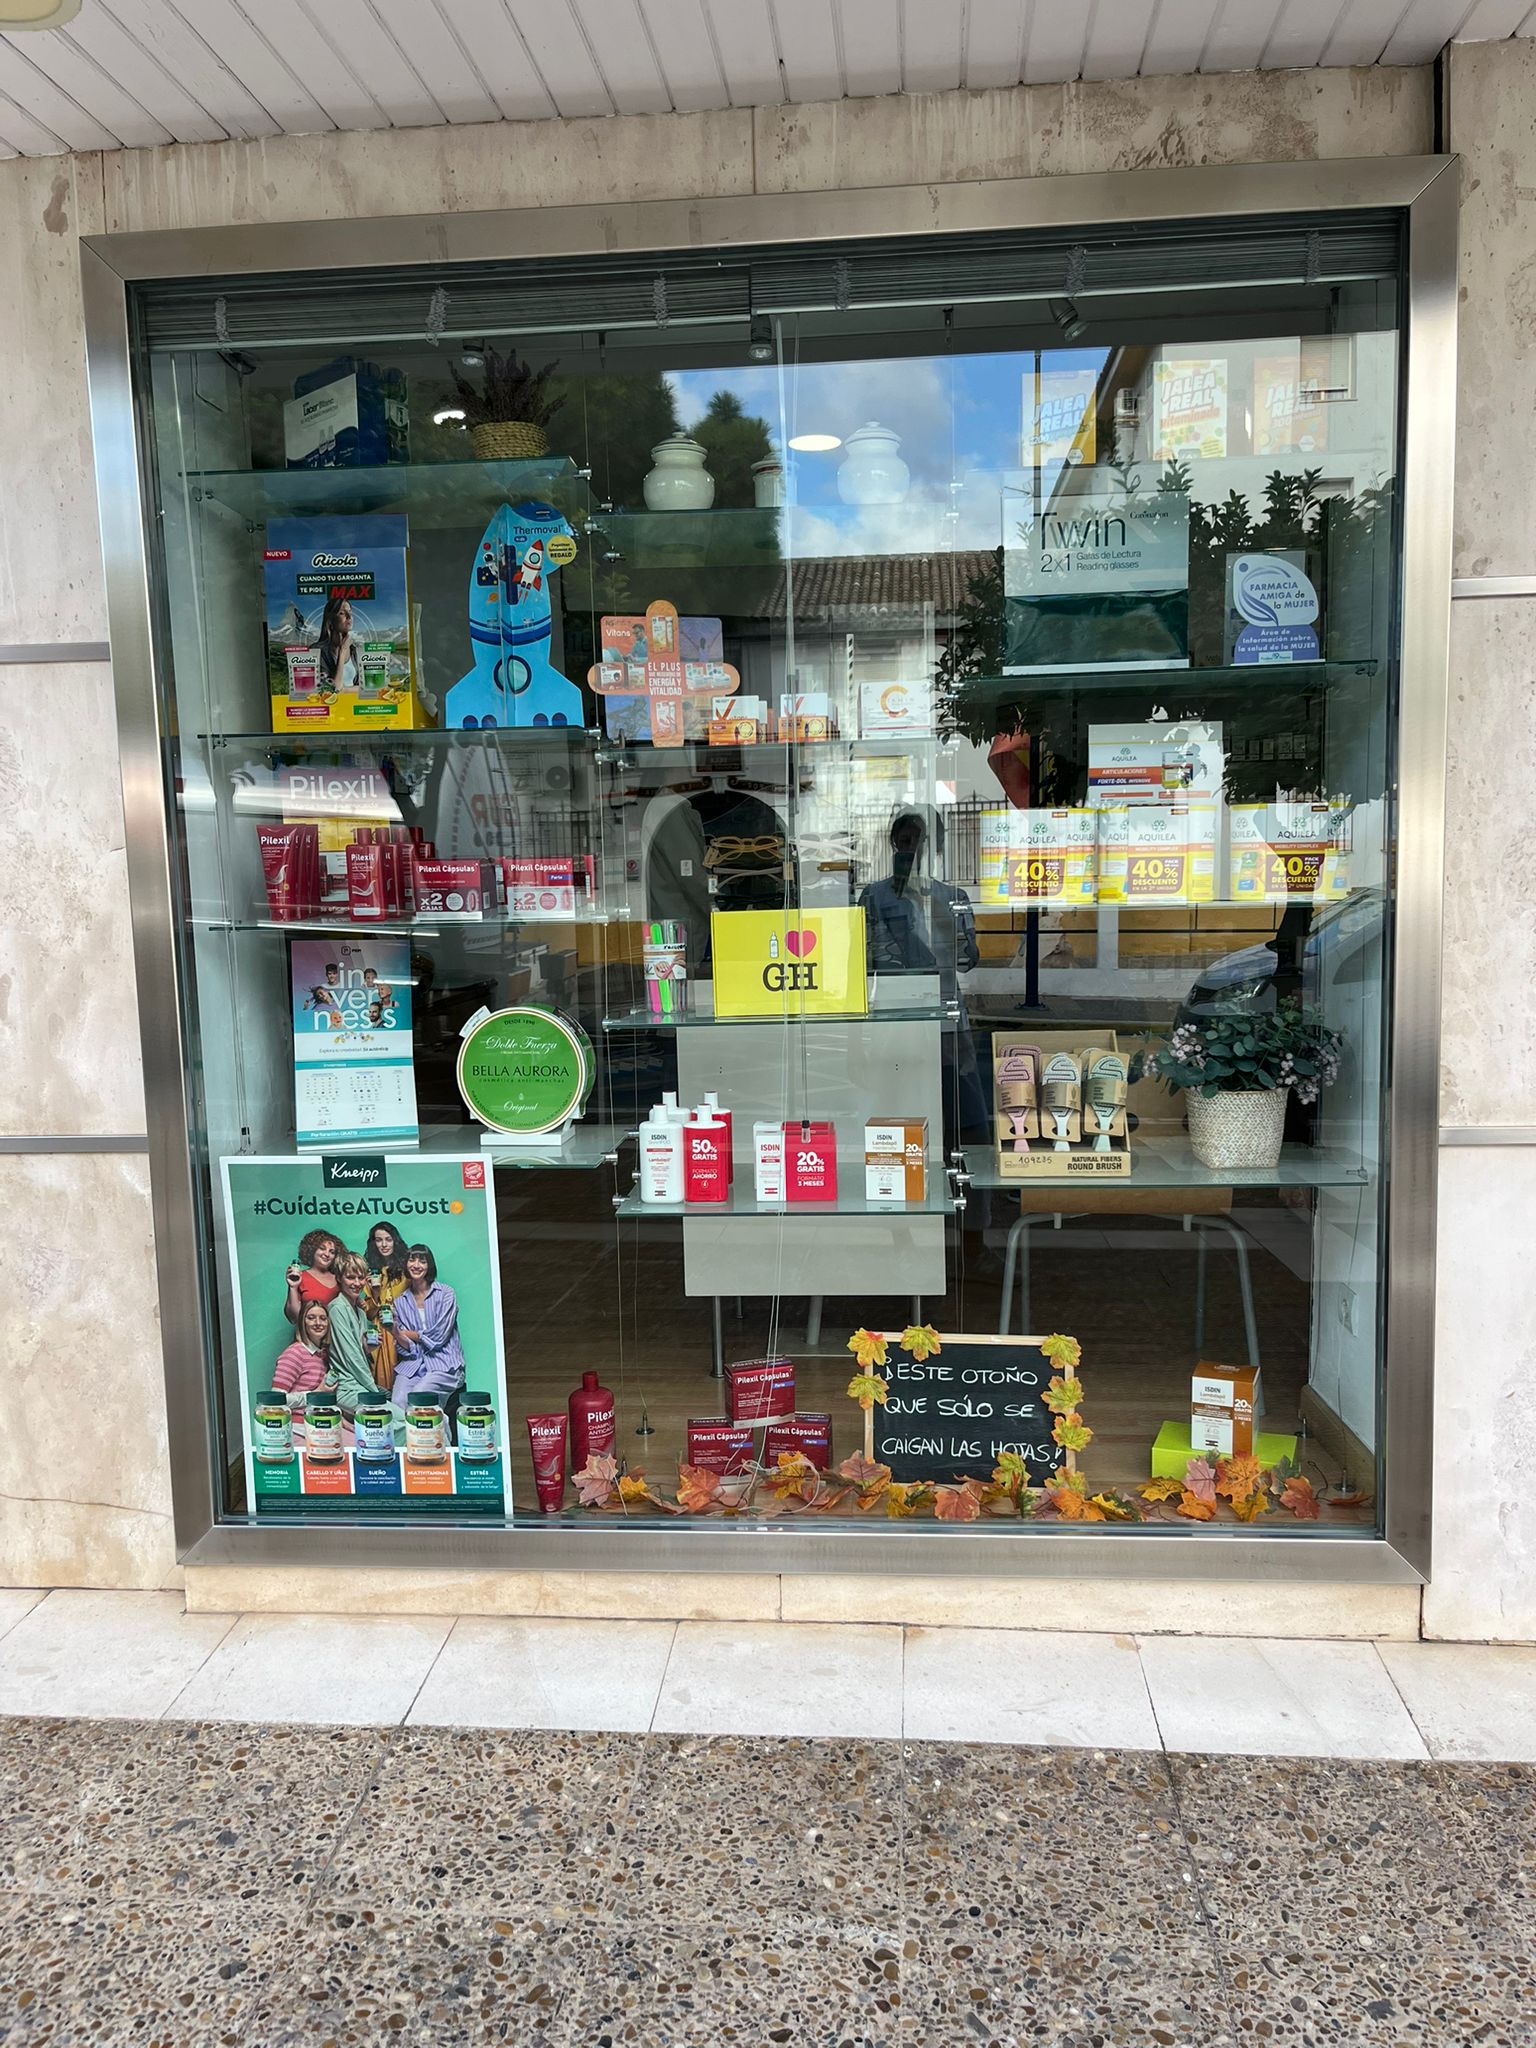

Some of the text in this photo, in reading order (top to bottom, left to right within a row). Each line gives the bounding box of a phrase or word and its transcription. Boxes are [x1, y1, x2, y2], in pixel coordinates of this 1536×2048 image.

[1163, 371, 1217, 405] JALEA
[1168, 388, 1214, 415] REAL
[513, 525, 561, 535] Thermoval
[1033, 510, 1126, 550] Twin
[313, 554, 357, 567] Ricola
[1040, 553, 1071, 573] 2x1
[1100, 550, 1111, 560] de
[1111, 550, 1142, 559] Lectura
[1076, 561, 1140, 572] Reading glasses
[330, 585, 372, 599] MAX
[1250, 582, 1298, 591] FARMACIA
[1260, 590, 1305, 600] AMIGA de
[1284, 600, 1315, 609] MUJER
[606, 629, 631, 637] Vitans
[1247, 644, 1267, 652] salud
[291, 656, 316, 664] Ricola
[361, 654, 386, 662] Ricola
[648, 662, 681, 671] EL PLUS
[675, 678, 681, 686] Y
[649, 687, 682, 696] VITALIDAD
[289, 774, 377, 800] Pilexil
[260, 836, 290, 844] Pilexil
[1138, 833, 1176, 841] AQUILEA
[1277, 830, 1317, 839] AQUILEA
[351, 853, 375, 861] Pilexil
[418, 864, 475, 874] Pilexil Cápsulas
[510, 863, 567, 872] Pilexil Cápsulas
[420, 892, 443, 906] x2
[338, 962, 365, 989] in
[762, 962, 818, 992] GH
[485, 1035, 558, 1055] Doble Fuerza
[472, 1065, 569, 1077] BELLA AURORA
[503, 1101, 538, 1114] Original
[692, 1139, 717, 1153] 50%
[797, 1151, 824, 1166] 20%
[330, 1161, 380, 1183] Kneipp
[737, 1371, 790, 1384] Pilexil Cápsulas
[961, 1366, 1038, 1385] OTOÑO
[883, 1394, 1036, 1418] QUE SÓLO SE
[365, 1429, 384, 1437] Sueño
[531, 1426, 561, 1437] Pilexil
[693, 1432, 748, 1441] Pilexil Cápsulas
[791, 1427, 822, 1436] Cápsulas
[881, 1433, 944, 1456] CAIGAN
[951, 1437, 982, 1457] LAS
